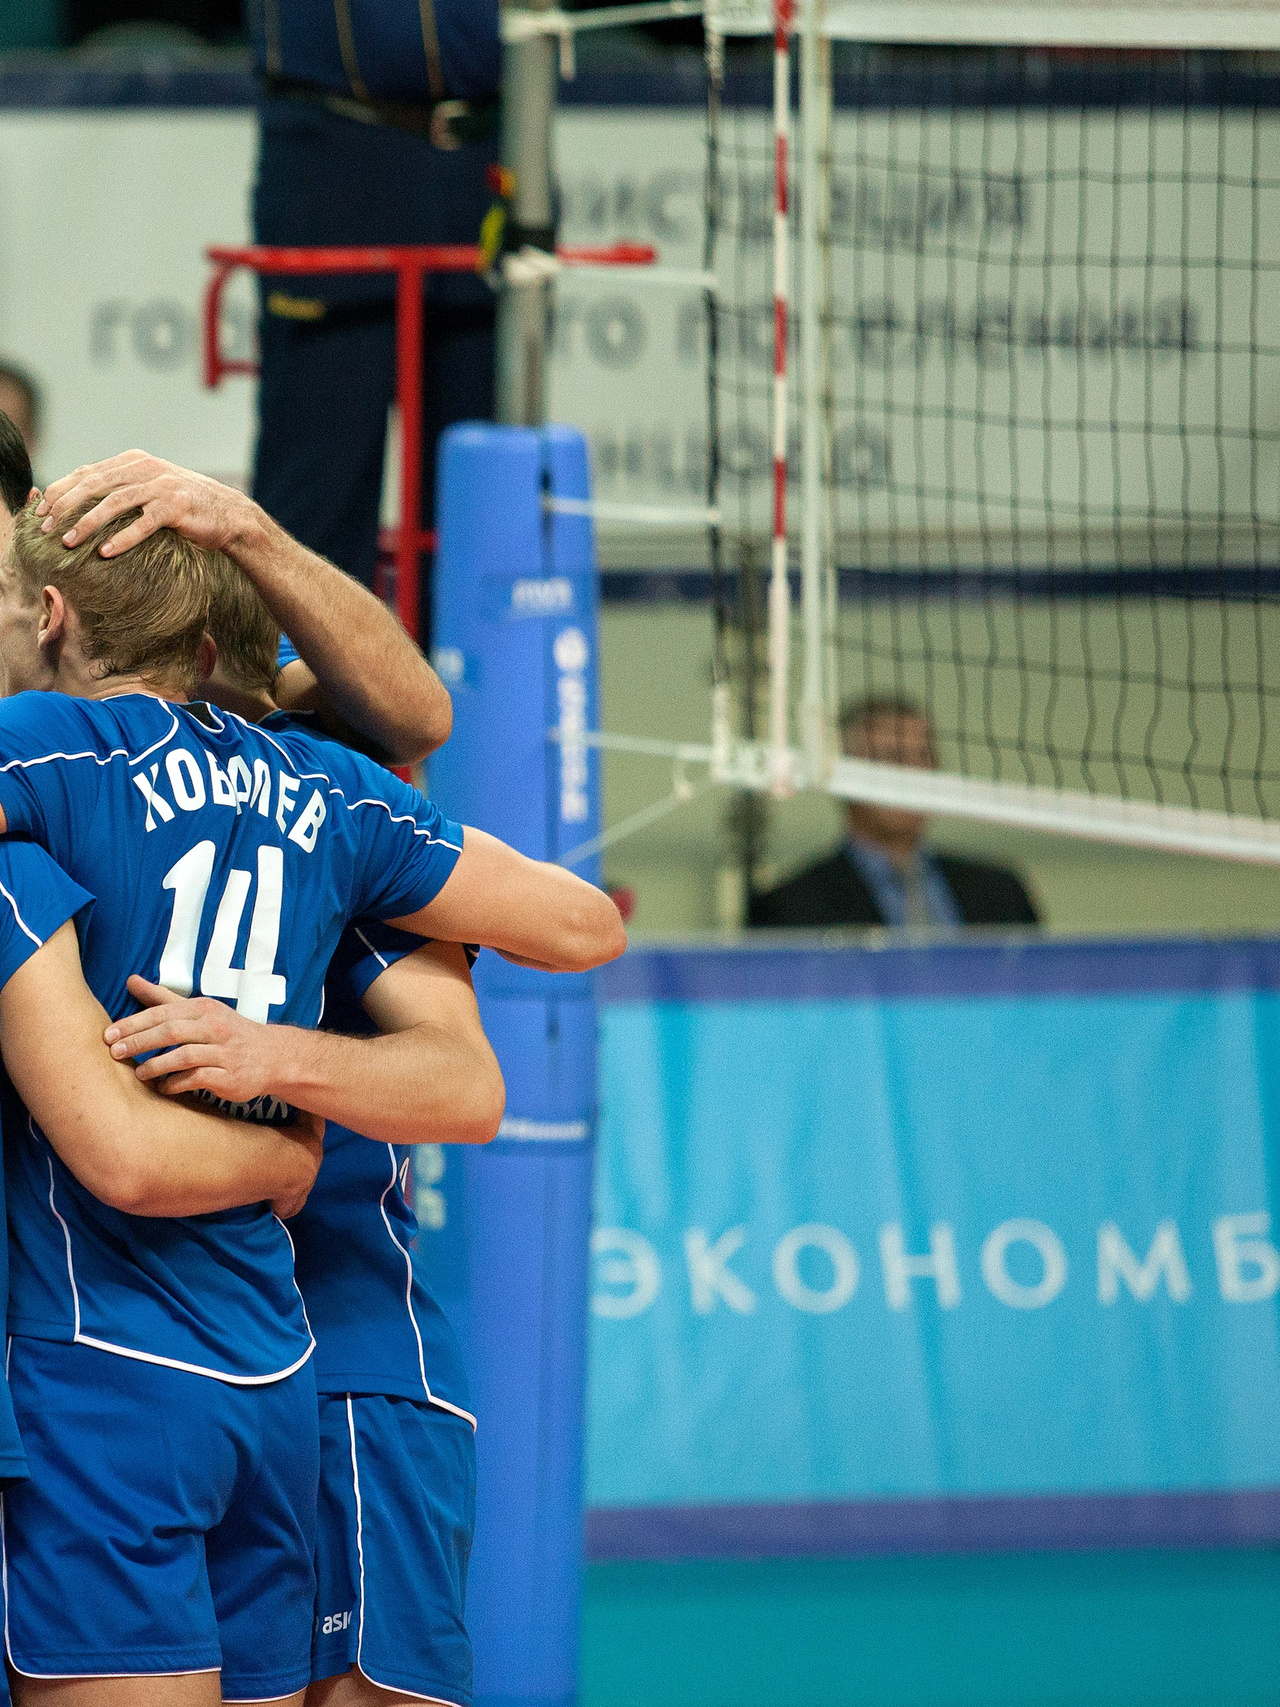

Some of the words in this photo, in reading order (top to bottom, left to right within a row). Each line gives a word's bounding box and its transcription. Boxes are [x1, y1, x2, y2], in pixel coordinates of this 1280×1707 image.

[161, 839, 287, 1026] 14
[589, 1210, 1280, 1320] ЭКОНОМБ
[322, 1611, 353, 1635] asi
